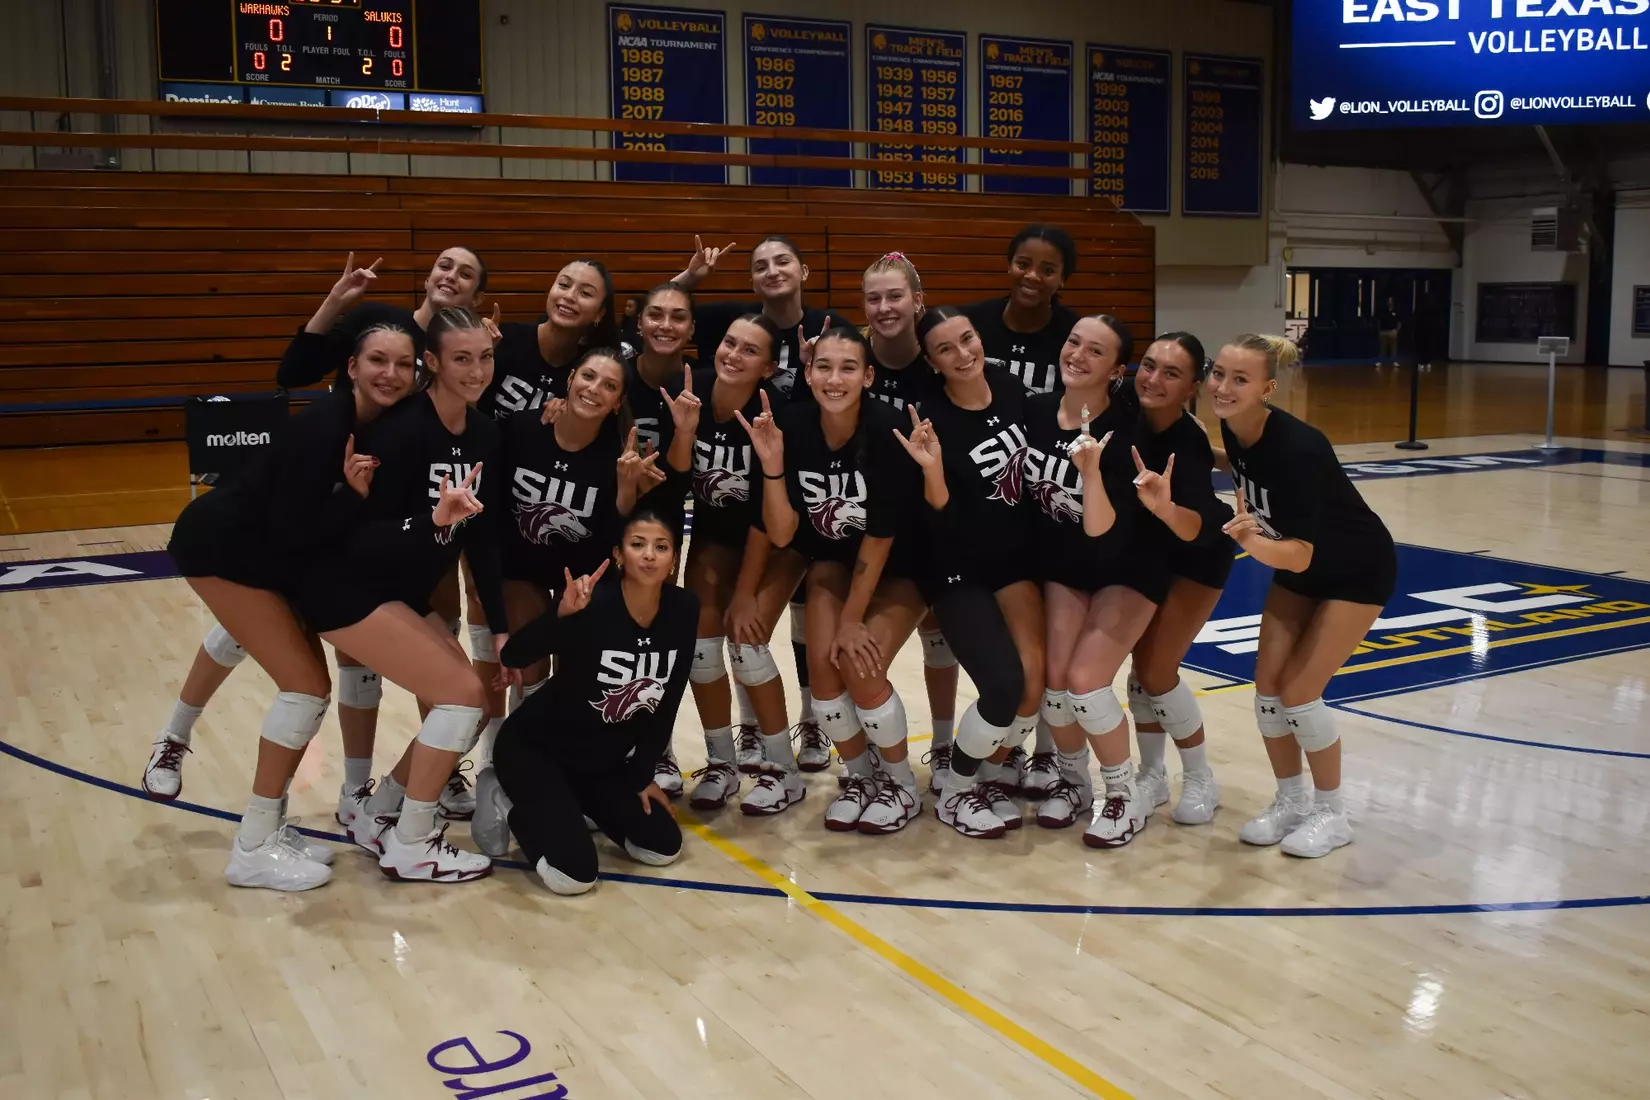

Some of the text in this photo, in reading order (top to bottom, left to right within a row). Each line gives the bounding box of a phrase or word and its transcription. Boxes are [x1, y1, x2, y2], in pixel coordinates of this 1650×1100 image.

[240, 3, 290, 16] WARHAWKS
[364, 11, 403, 23] SALUKIS
[1342, 0, 1650, 23] EAST TEXAS
[313, 13, 339, 22] PERIOD
[269, 18, 283, 41] 0
[327, 25, 332, 41] 1
[638, 19, 720, 34] VOLLEYBALL
[389, 25, 403, 48] 0
[770, 28, 847, 42] VOLLEYBALL
[908, 36, 945, 48] MEN'S
[1468, 27, 1648, 54] VOLLEYBALL
[245, 43, 268, 51] FOULS
[302, 45, 350, 56] PLAYER FOUL
[618, 36, 718, 50] NCAA TOURNAMENT
[358, 48, 376, 57] T.O.L.
[384, 50, 406, 58] FOULS
[621, 49, 665, 65] 1986
[889, 44, 922, 56] TRACK
[936, 47, 962, 58] FIELD
[1019, 46, 1054, 56] MEN'S
[254, 51, 265, 70] 0
[281, 53, 292, 71] 2
[362, 57, 373, 75] 2
[392, 59, 403, 76] 0
[755, 57, 795, 73] 1986
[245, 73, 270, 82] SCORE
[315, 76, 340, 84] MATCH
[621, 67, 663, 83] 1987
[877, 66, 957, 84] 1939 1956
[990, 74, 1023, 89] 1967
[384, 79, 408, 87] SCORE
[755, 75, 794, 91] 1987
[1095, 83, 1127, 96] 1999
[621, 86, 665, 102] 1988
[877, 83, 956, 101] 1942 1957
[989, 91, 1023, 105] 2015
[440, 97, 459, 107] Hunt
[755, 93, 795, 108] 2018
[1094, 98, 1129, 112] 2003
[1339, 99, 1470, 115] @LION_VOLLEYBALL
[1510, 96, 1636, 110] @LIONVOLLEYBALL
[622, 104, 664, 120] 2017
[877, 101, 957, 118] 1947 1958
[989, 108, 1023, 122] 2016
[755, 111, 795, 126] 2019
[1094, 114, 1128, 128] 2004
[877, 118, 957, 135] 1948 1959
[989, 124, 1022, 138] 2017
[1094, 146, 1125, 160] 2013
[1191, 151, 1219, 164] 2015
[1094, 162, 1124, 175] 2014
[877, 170, 957, 185] 1953 1965
[1094, 177, 1124, 191] 2015
[207, 431, 270, 447] molten
[511, 466, 599, 519] SIU
[798, 470, 868, 504] SIU
[596, 649, 678, 686] SIU
